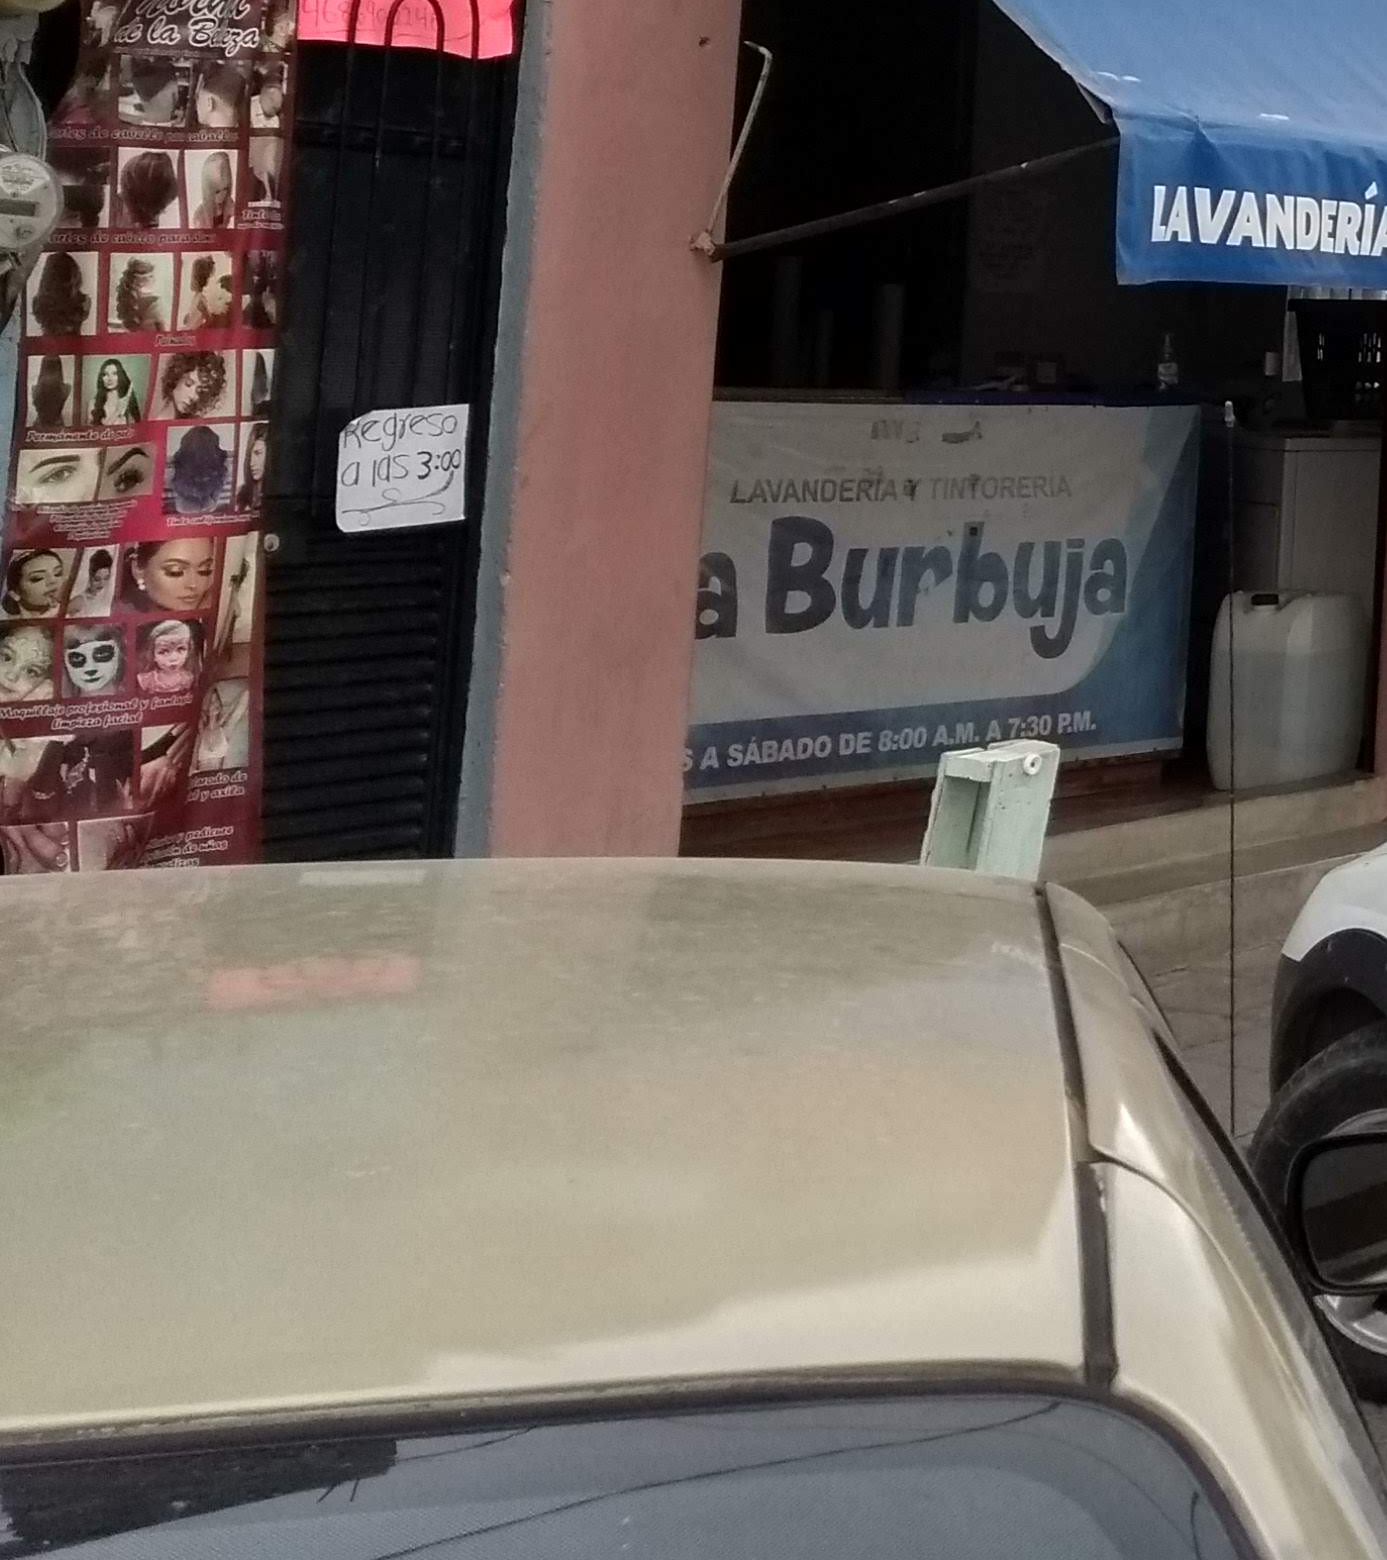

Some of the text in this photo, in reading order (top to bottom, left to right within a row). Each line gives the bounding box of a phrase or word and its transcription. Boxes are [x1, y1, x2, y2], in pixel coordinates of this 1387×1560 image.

[147, 15, 181, 46] la
[341, 411, 460, 450] Regreso
[370, 453, 410, 488] las
[415, 447, 463, 482] 3:00
[764, 516, 1129, 659] Burbuja
[701, 747, 720, 770] A
[727, 735, 833, 768] SÁBADO
[840, 731, 872, 756] DE
[878, 726, 928, 751] 8:00
[932, 722, 980, 748] A.M.
[985, 718, 1002, 741] A
[1008, 713, 1053, 739] 7:30
[1057, 709, 1097, 735] P.M.
